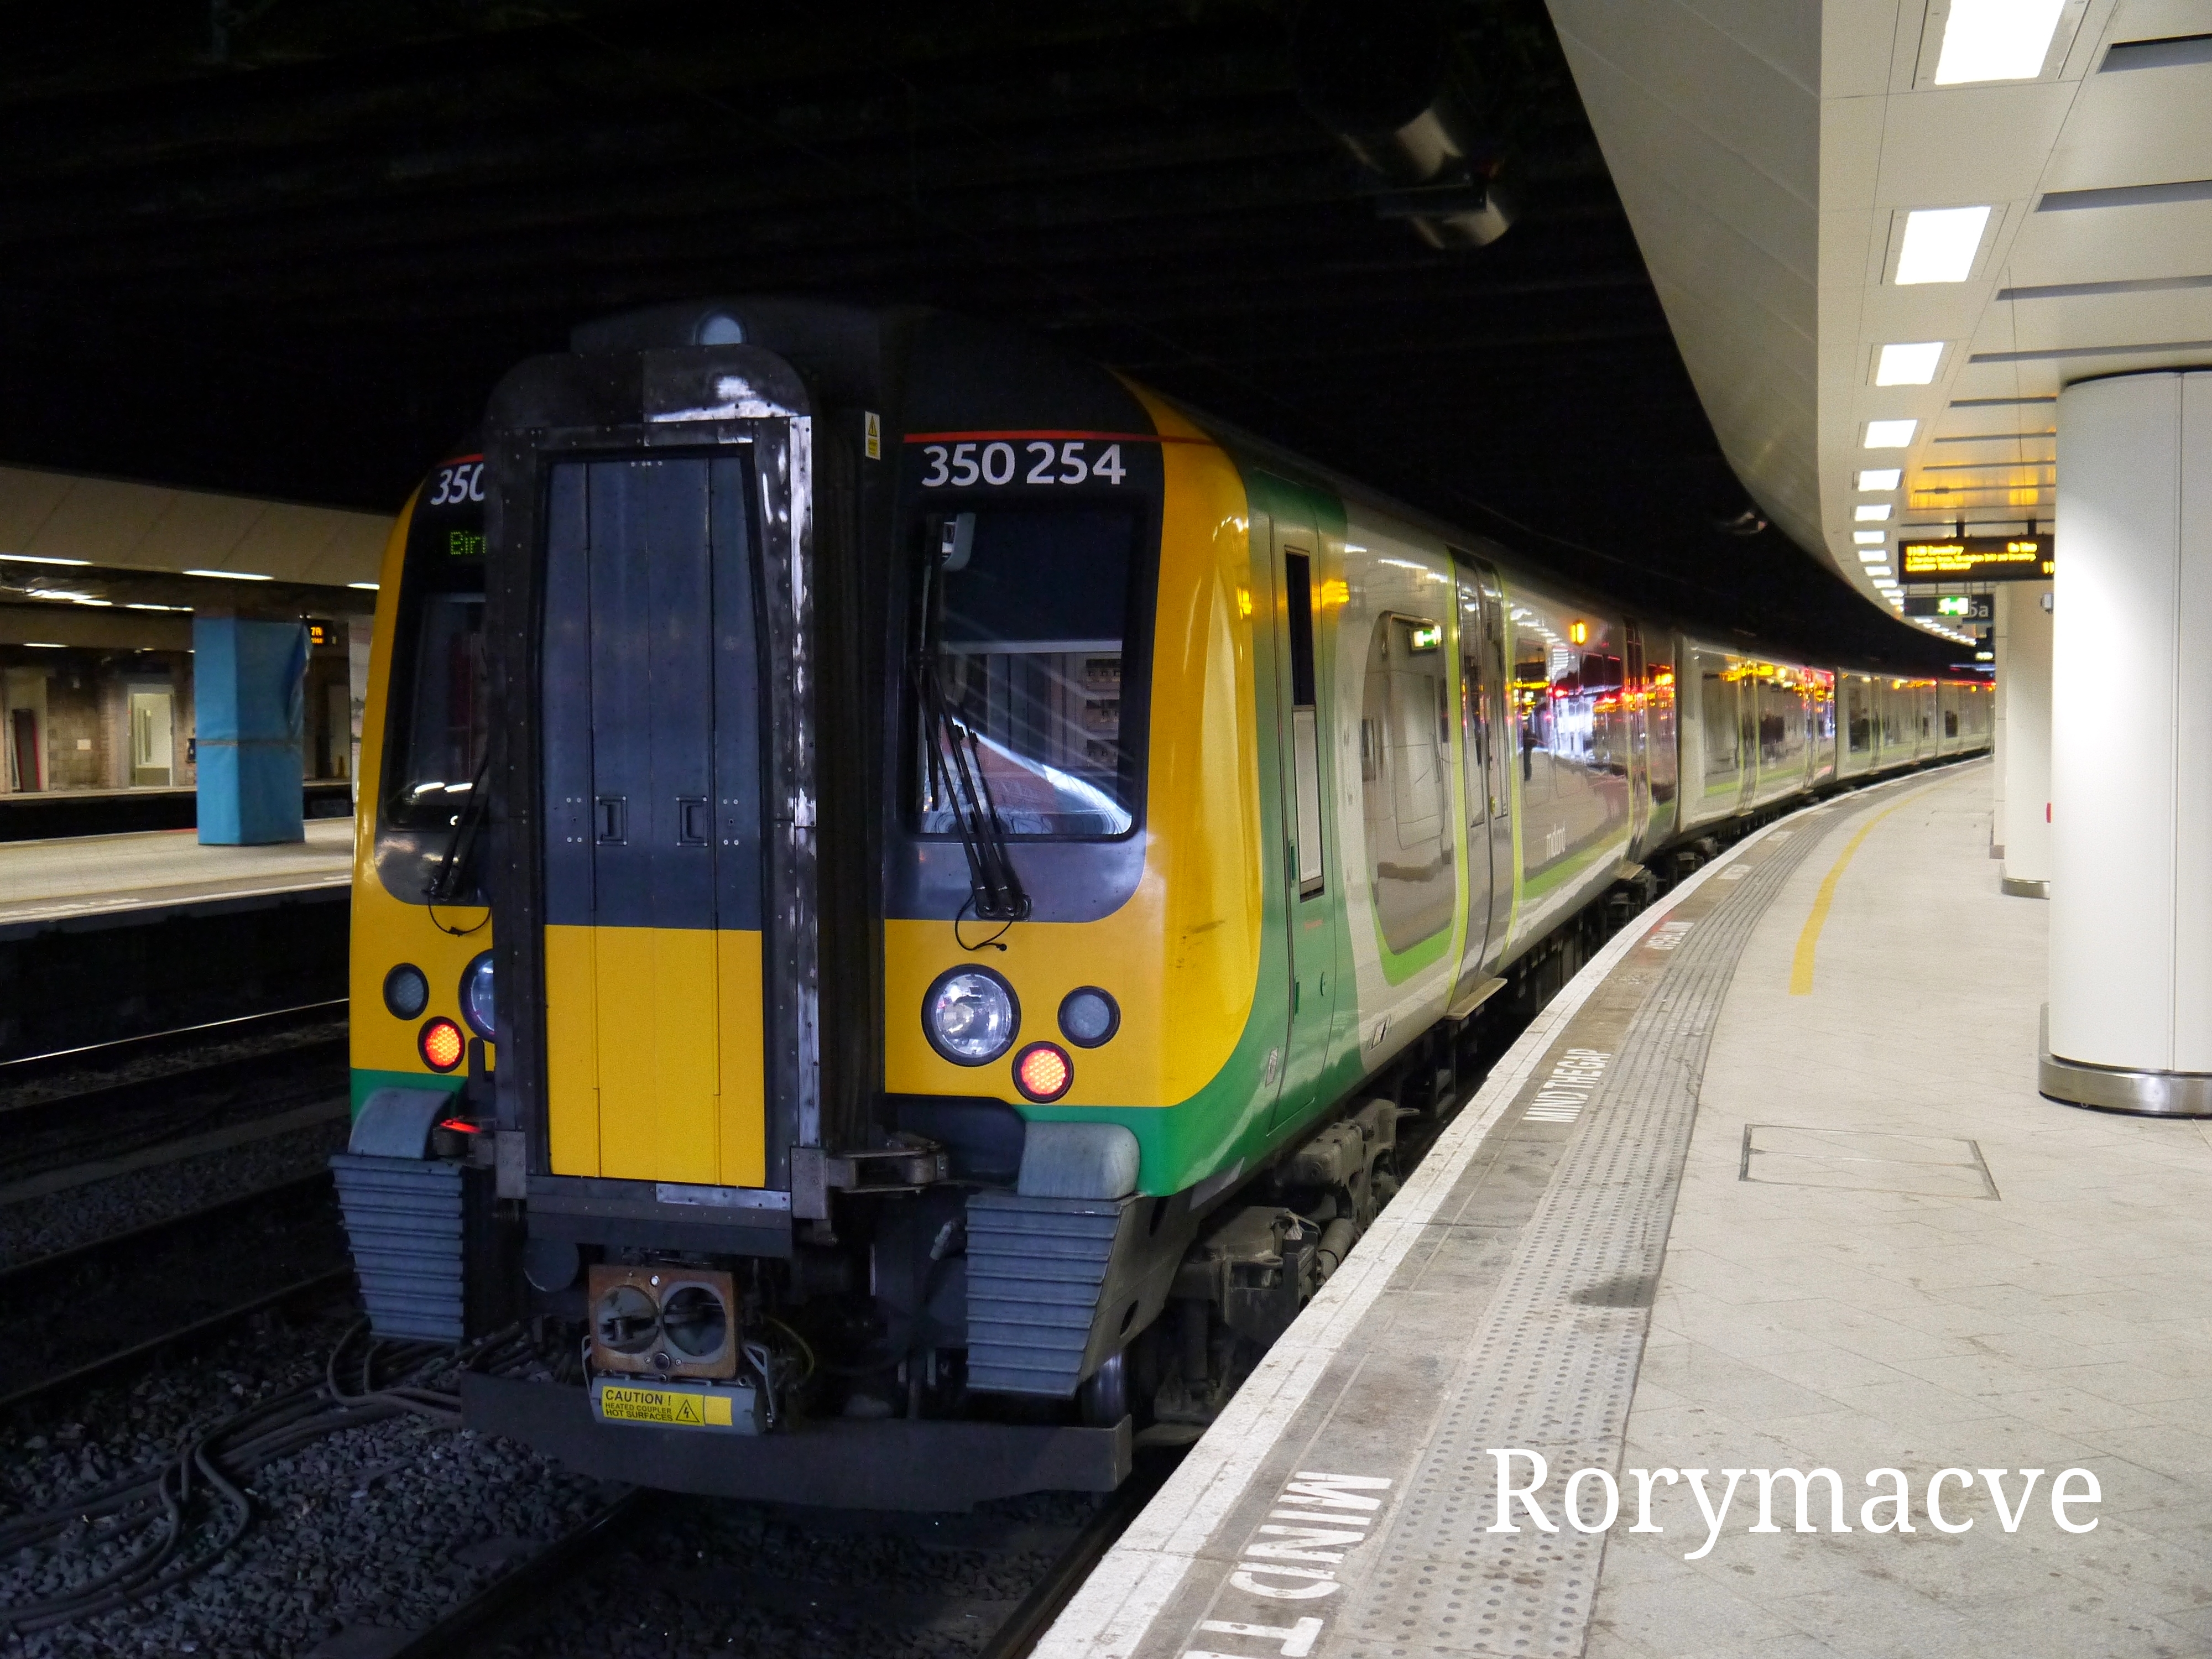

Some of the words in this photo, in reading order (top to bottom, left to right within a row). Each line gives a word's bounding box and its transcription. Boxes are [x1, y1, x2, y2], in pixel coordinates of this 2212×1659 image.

[921, 442, 1015, 487] 350
[1026, 442, 1126, 484] 254
[450, 531, 486, 555] Bir
[1557, 1048, 1612, 1070] GAP
[1543, 1068, 1603, 1089] THE
[1522, 1091, 1589, 1123] MIND
[606, 1389, 662, 1405] CAUTION
[606, 1402, 634, 1411] HEATED
[636, 1405, 672, 1415] COUPLER
[606, 1409, 624, 1417] HOT
[626, 1410, 673, 1422] SURFACES
[1229, 1471, 1393, 1599] MIND
